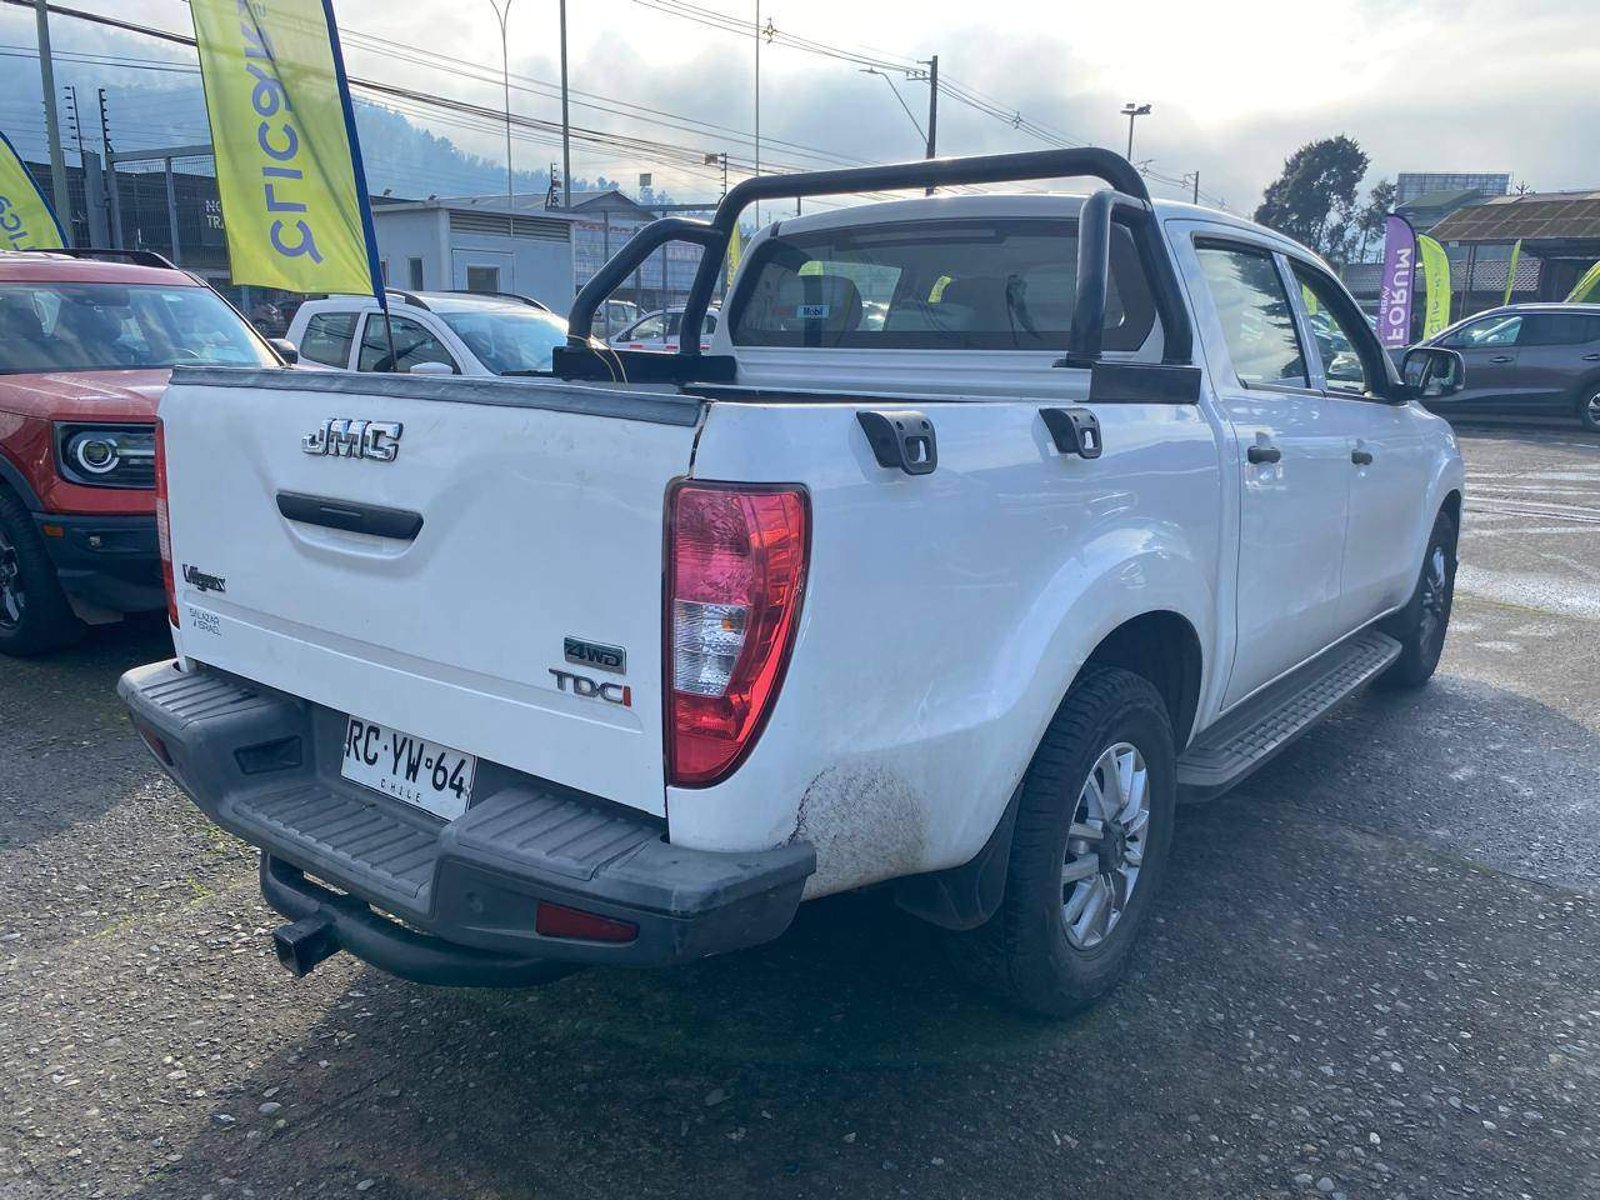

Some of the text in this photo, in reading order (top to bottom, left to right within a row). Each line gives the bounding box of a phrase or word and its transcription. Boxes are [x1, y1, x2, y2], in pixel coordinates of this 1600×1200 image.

[301, 418, 404, 462] JMC
[566, 641, 621, 667] 4WD
[380, 778, 421, 803] CHILE
